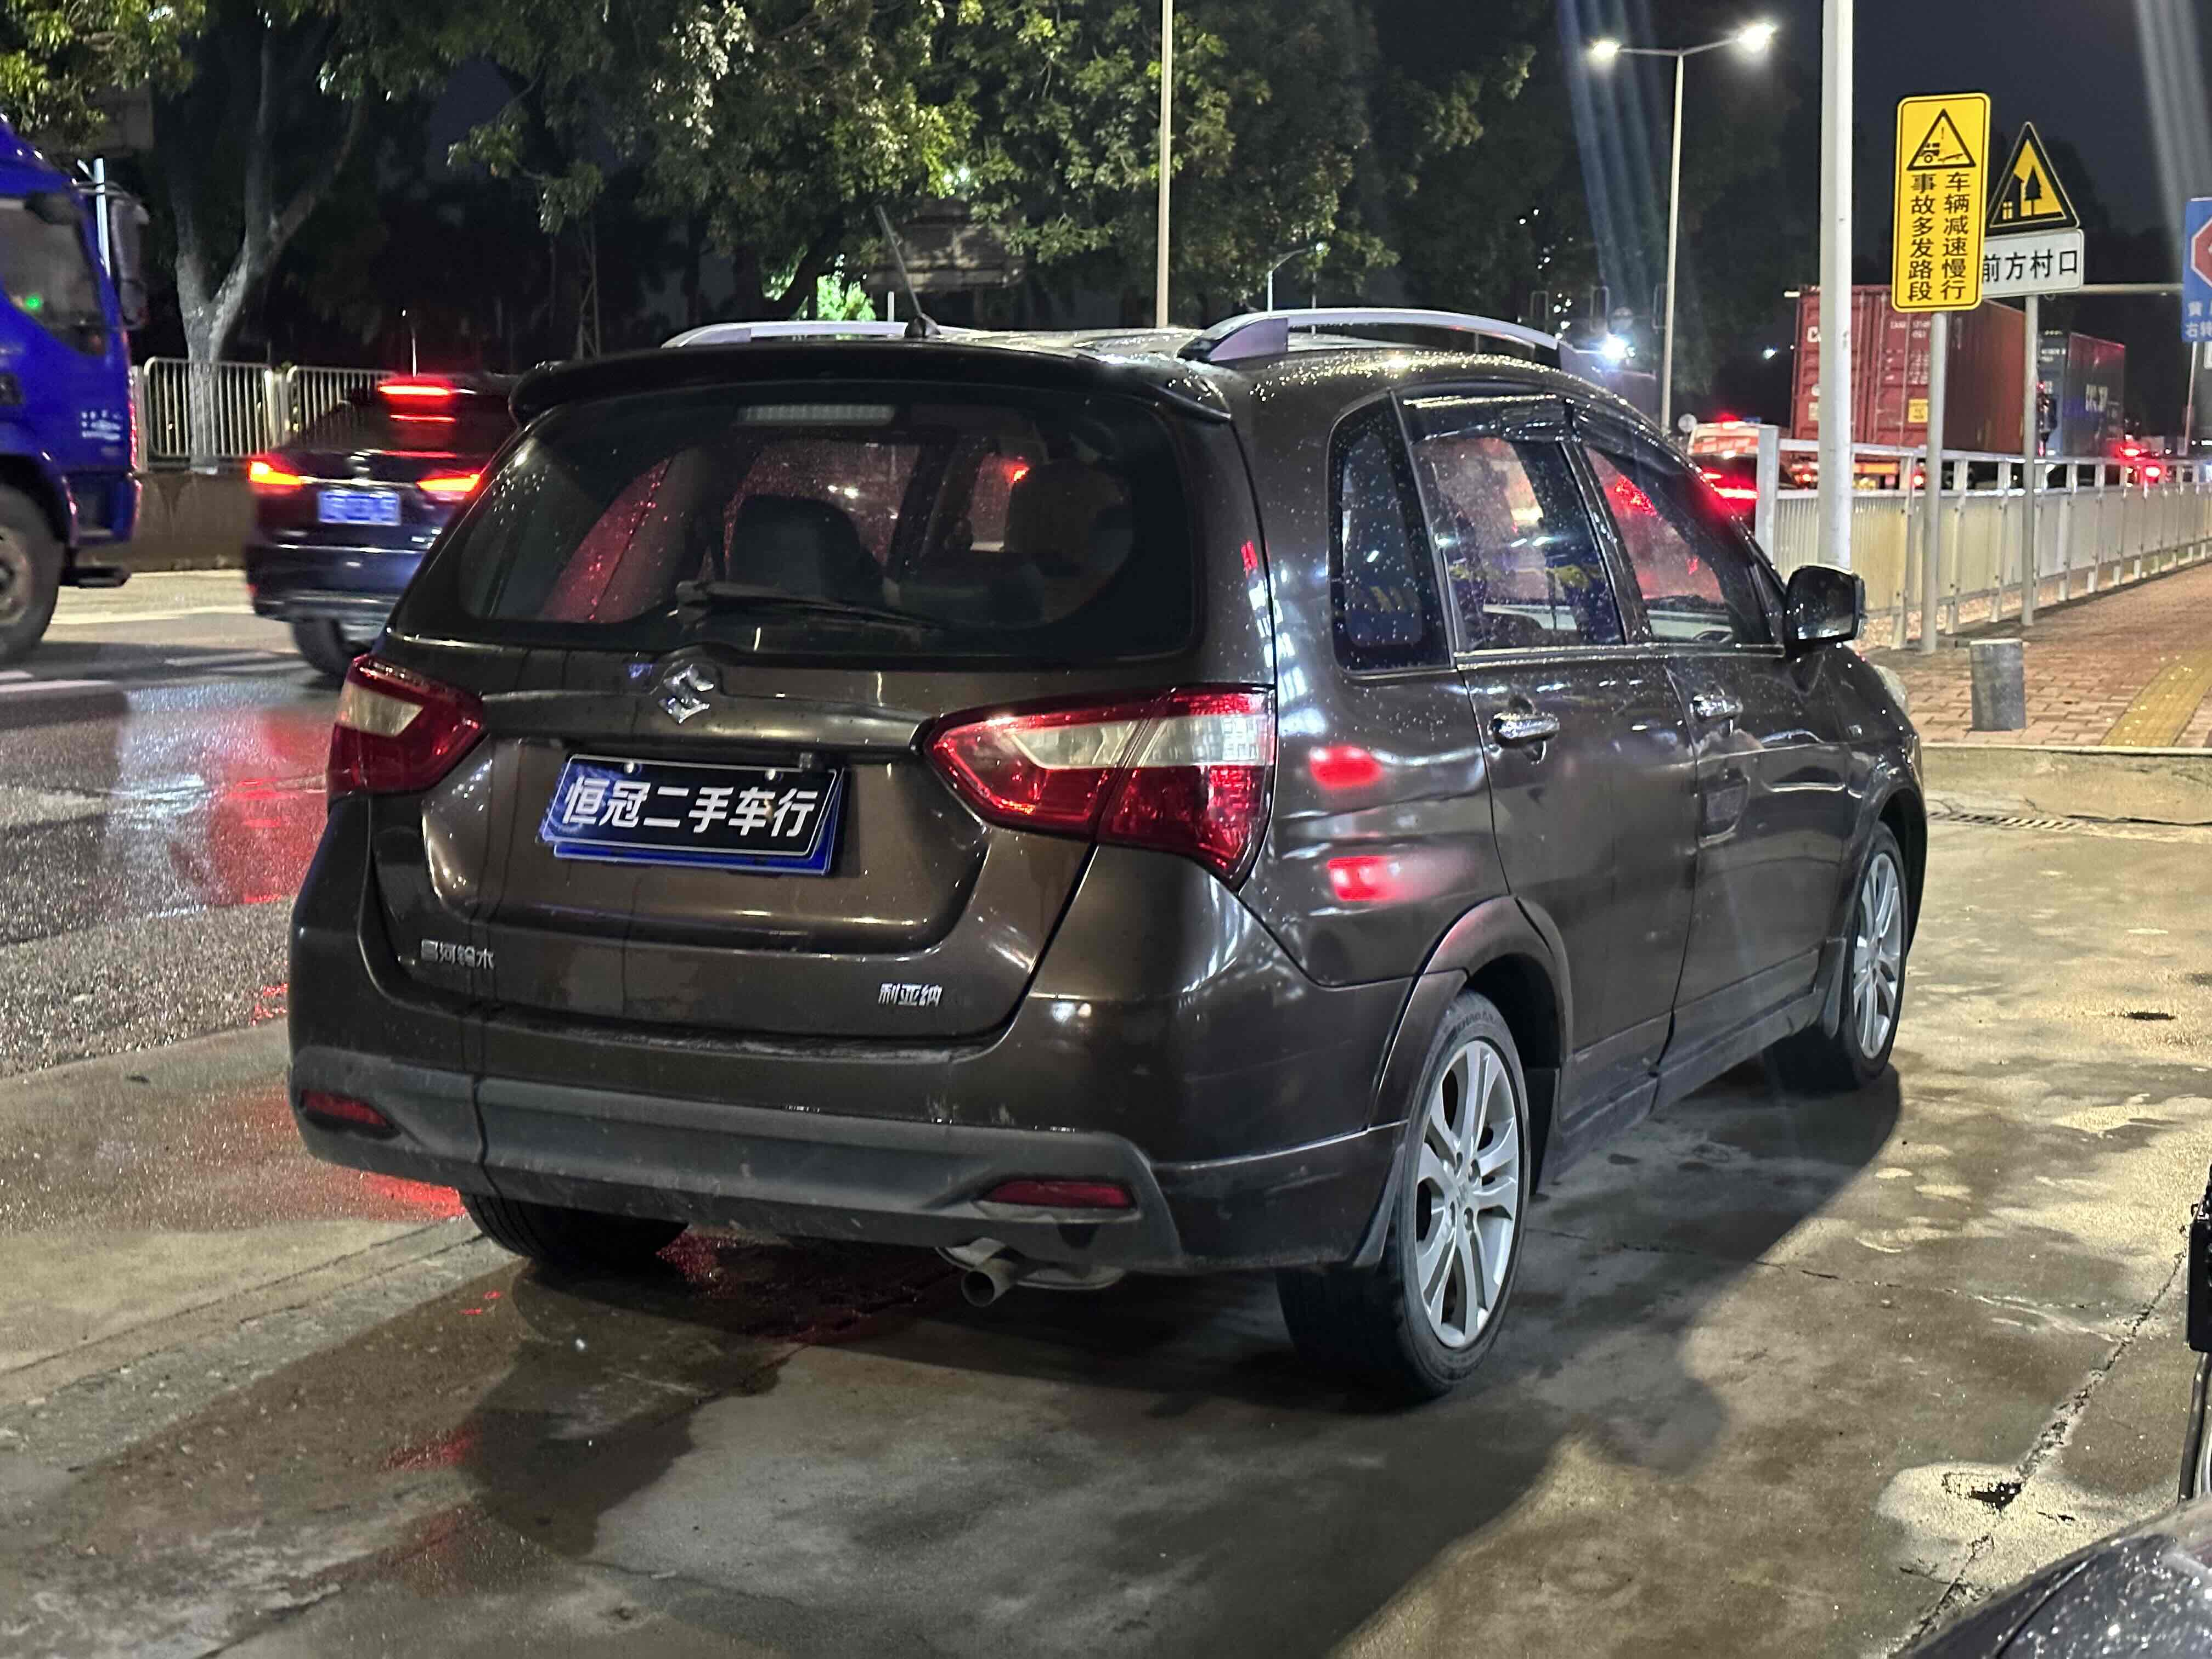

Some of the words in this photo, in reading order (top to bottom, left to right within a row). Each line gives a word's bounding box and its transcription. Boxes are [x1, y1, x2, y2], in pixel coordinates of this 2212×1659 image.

[1907, 173, 1937, 302] 事故多发路段
[1940, 171, 1971, 301] 车辆减速慢行
[1982, 249, 2078, 283] 前方村口
[562, 774, 818, 838] 恒冠二手车行
[878, 983, 943, 1007] 利亚纳
